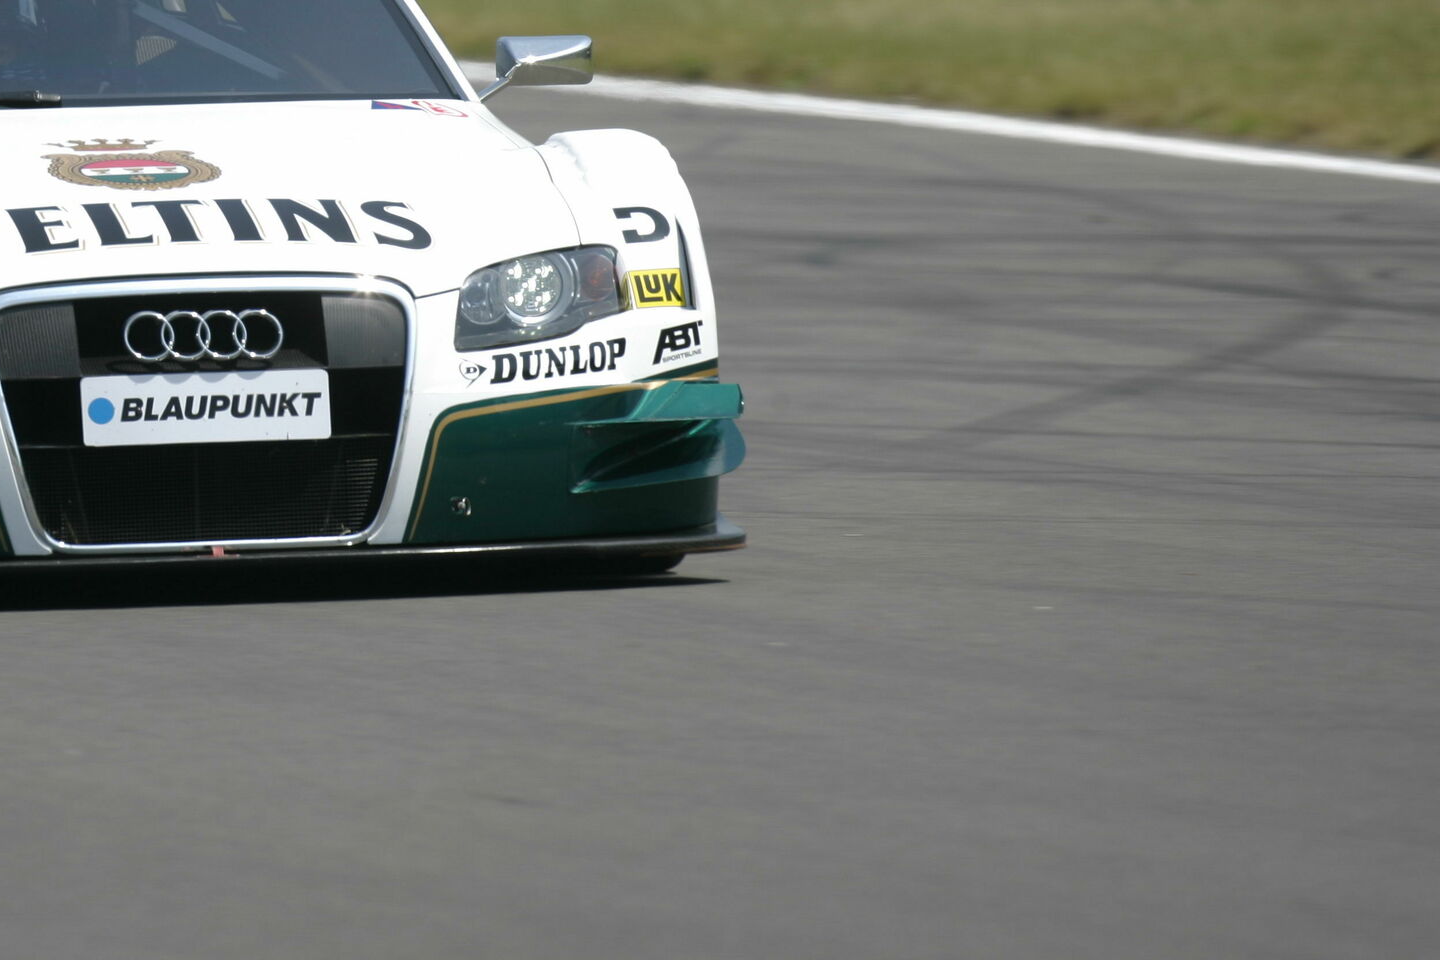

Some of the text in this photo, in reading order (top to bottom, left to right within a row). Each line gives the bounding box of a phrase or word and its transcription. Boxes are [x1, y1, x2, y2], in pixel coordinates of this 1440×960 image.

[490, 337, 627, 385] DUNLOP
[652, 320, 703, 365] ABT
[661, 348, 702, 364] SPORTSLINE
[120, 392, 322, 423] BLAUPUNKT
